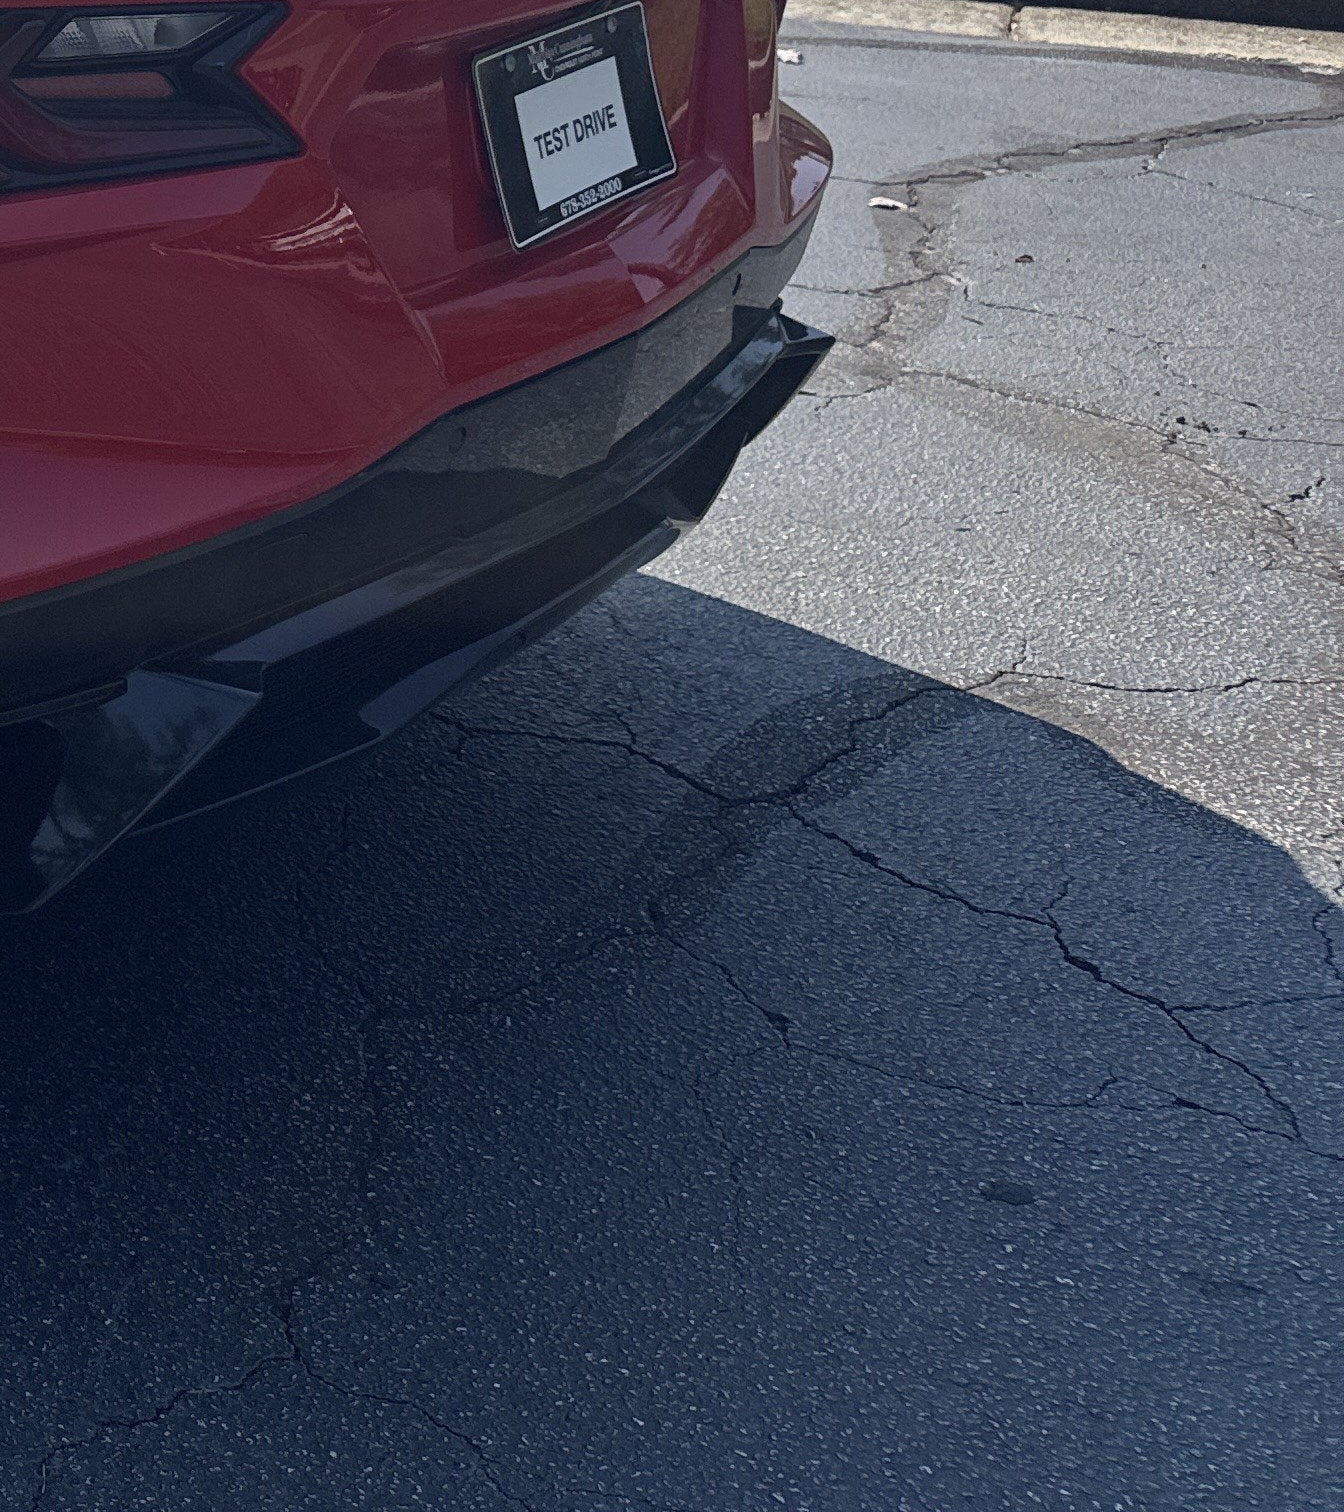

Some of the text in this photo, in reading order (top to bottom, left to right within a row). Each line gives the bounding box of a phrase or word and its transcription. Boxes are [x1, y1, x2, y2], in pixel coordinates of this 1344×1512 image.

[533, 104, 617, 159] TEST DRIVE
[559, 176, 623, 218] 678-352-2000
